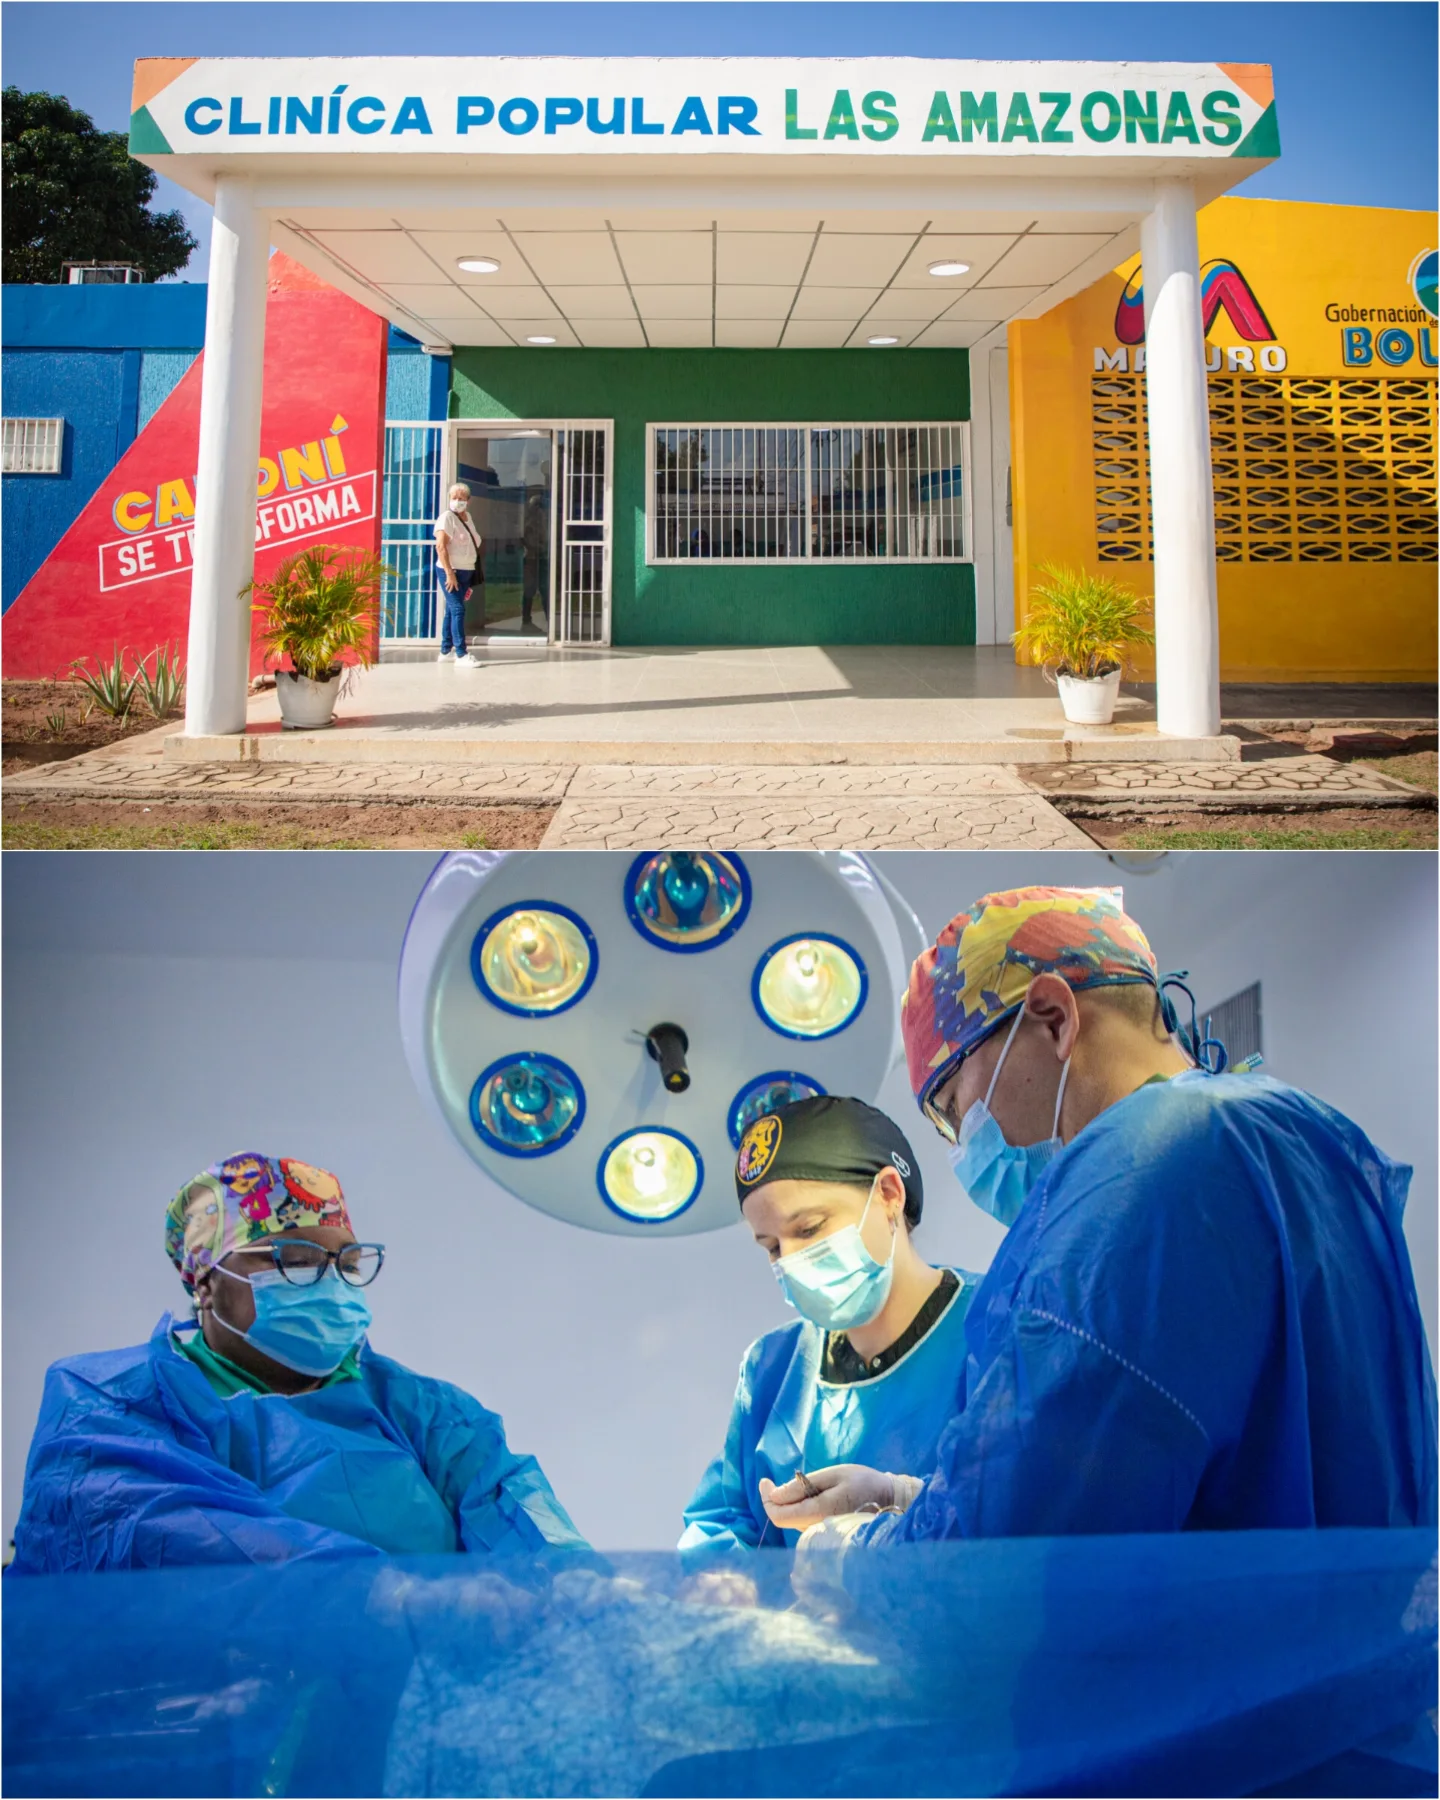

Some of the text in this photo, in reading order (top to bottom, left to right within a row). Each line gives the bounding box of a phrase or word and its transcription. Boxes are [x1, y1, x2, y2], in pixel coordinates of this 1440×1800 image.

[184, 84, 1243, 146] CLINÍCA POPULAR LAS AMAZONAS
[1325, 302, 1427, 323] Gobernación
[1093, 345, 1288, 373] MURO
[112, 413, 349, 535] CAONÍ
[117, 484, 362, 577] SE TFORMA
